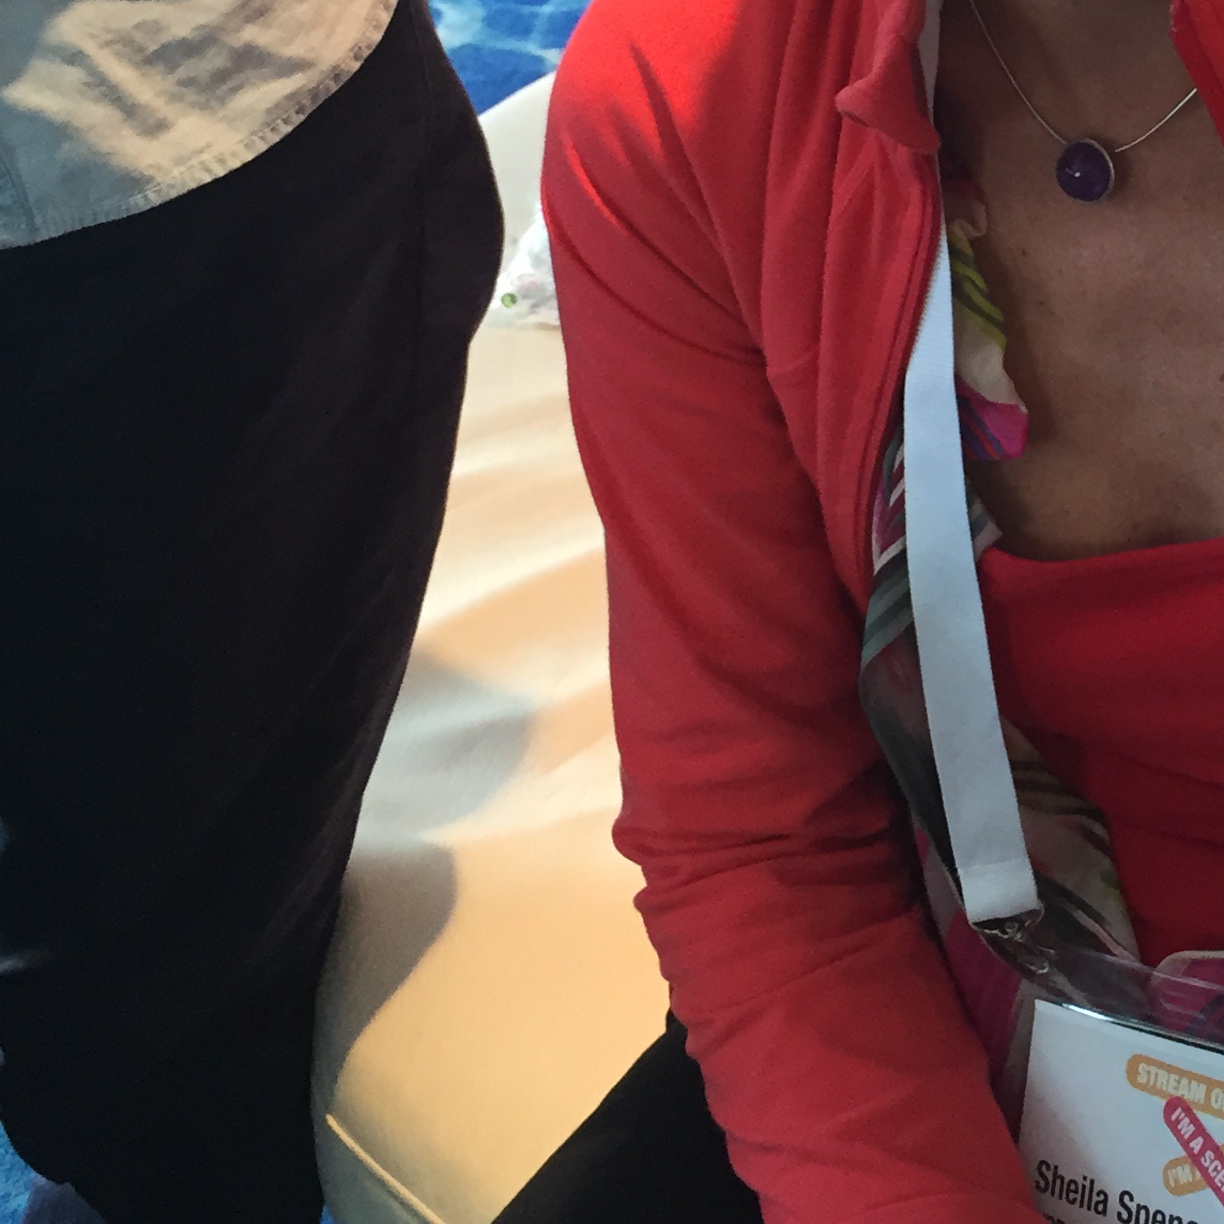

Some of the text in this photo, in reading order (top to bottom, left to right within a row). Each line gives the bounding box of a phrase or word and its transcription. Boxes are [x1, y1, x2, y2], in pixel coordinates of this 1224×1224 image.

[1137, 1062, 1206, 1104] STREAM
[1171, 1107, 1195, 1139] I'M
[1189, 1136, 1204, 1155] A
[1035, 1159, 1109, 1217] Sheila
[1167, 1163, 1192, 1187] I'M
